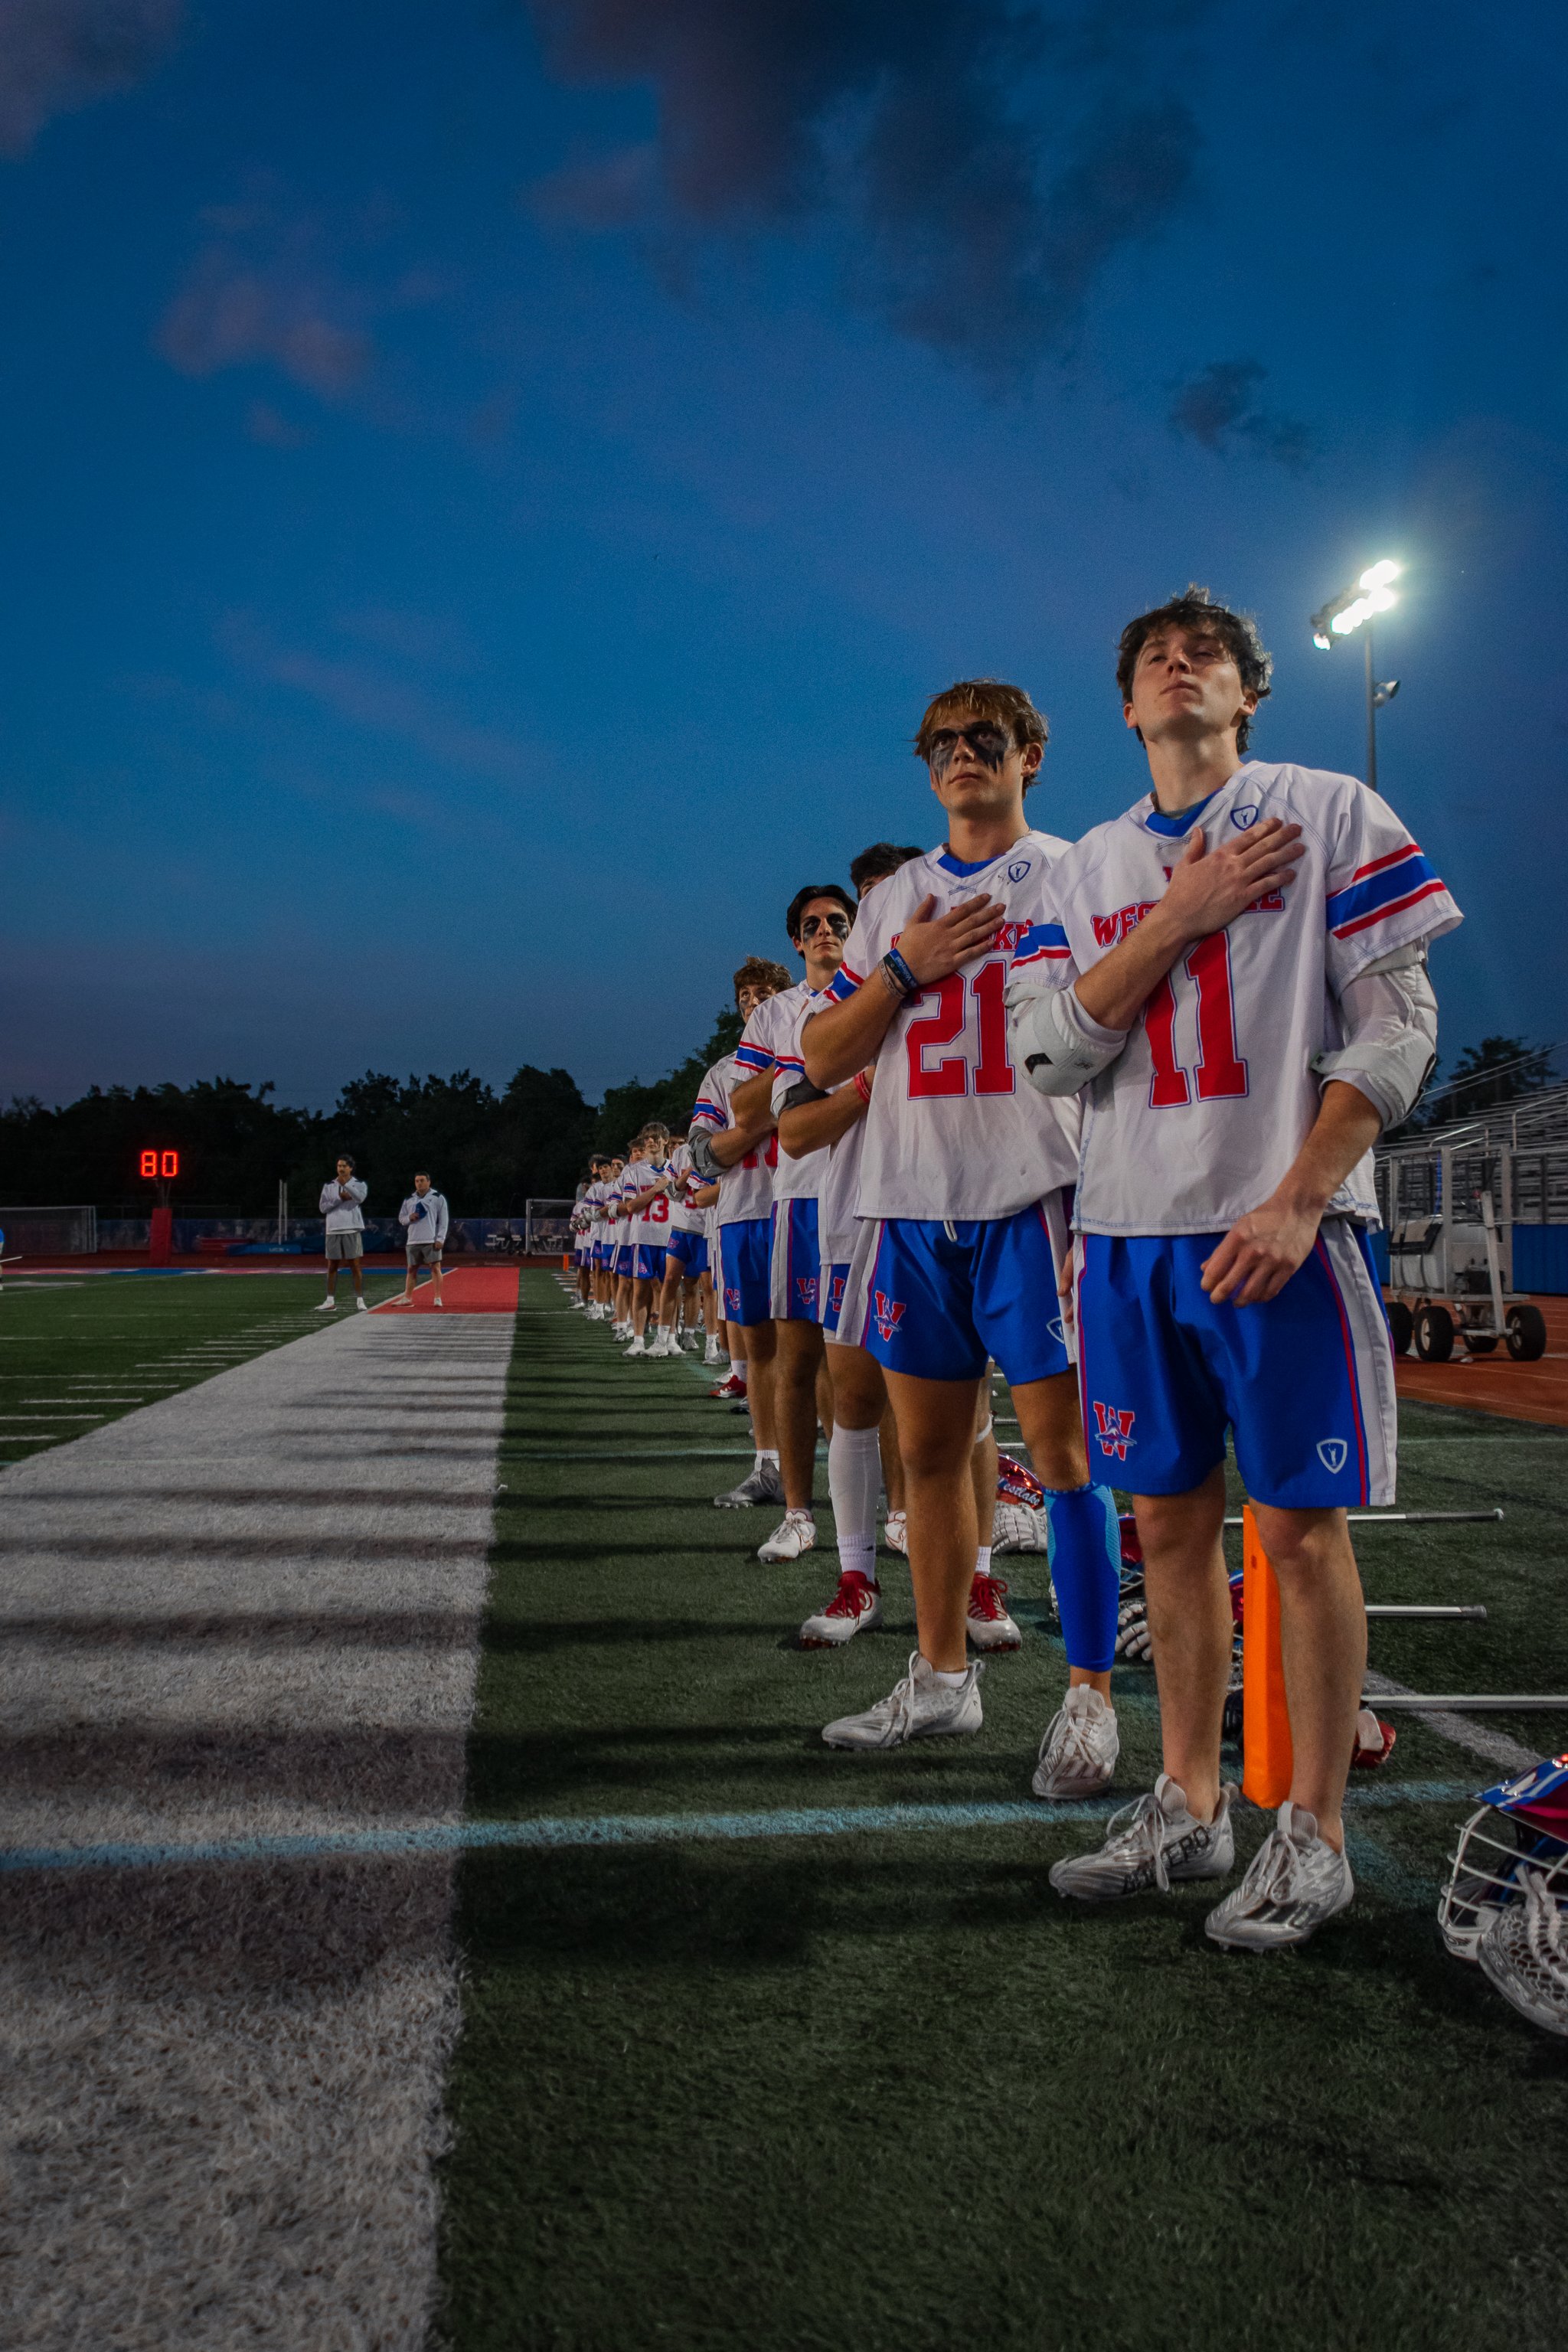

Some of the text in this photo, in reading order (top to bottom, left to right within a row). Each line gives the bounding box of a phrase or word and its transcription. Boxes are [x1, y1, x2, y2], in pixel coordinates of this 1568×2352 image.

[1091, 886, 1285, 949] WESE
[902, 959, 1016, 1100] 21
[1145, 927, 1250, 1109] 11
[141, 1148, 178, 1177] 80
[1093, 1400, 1137, 1462] W
